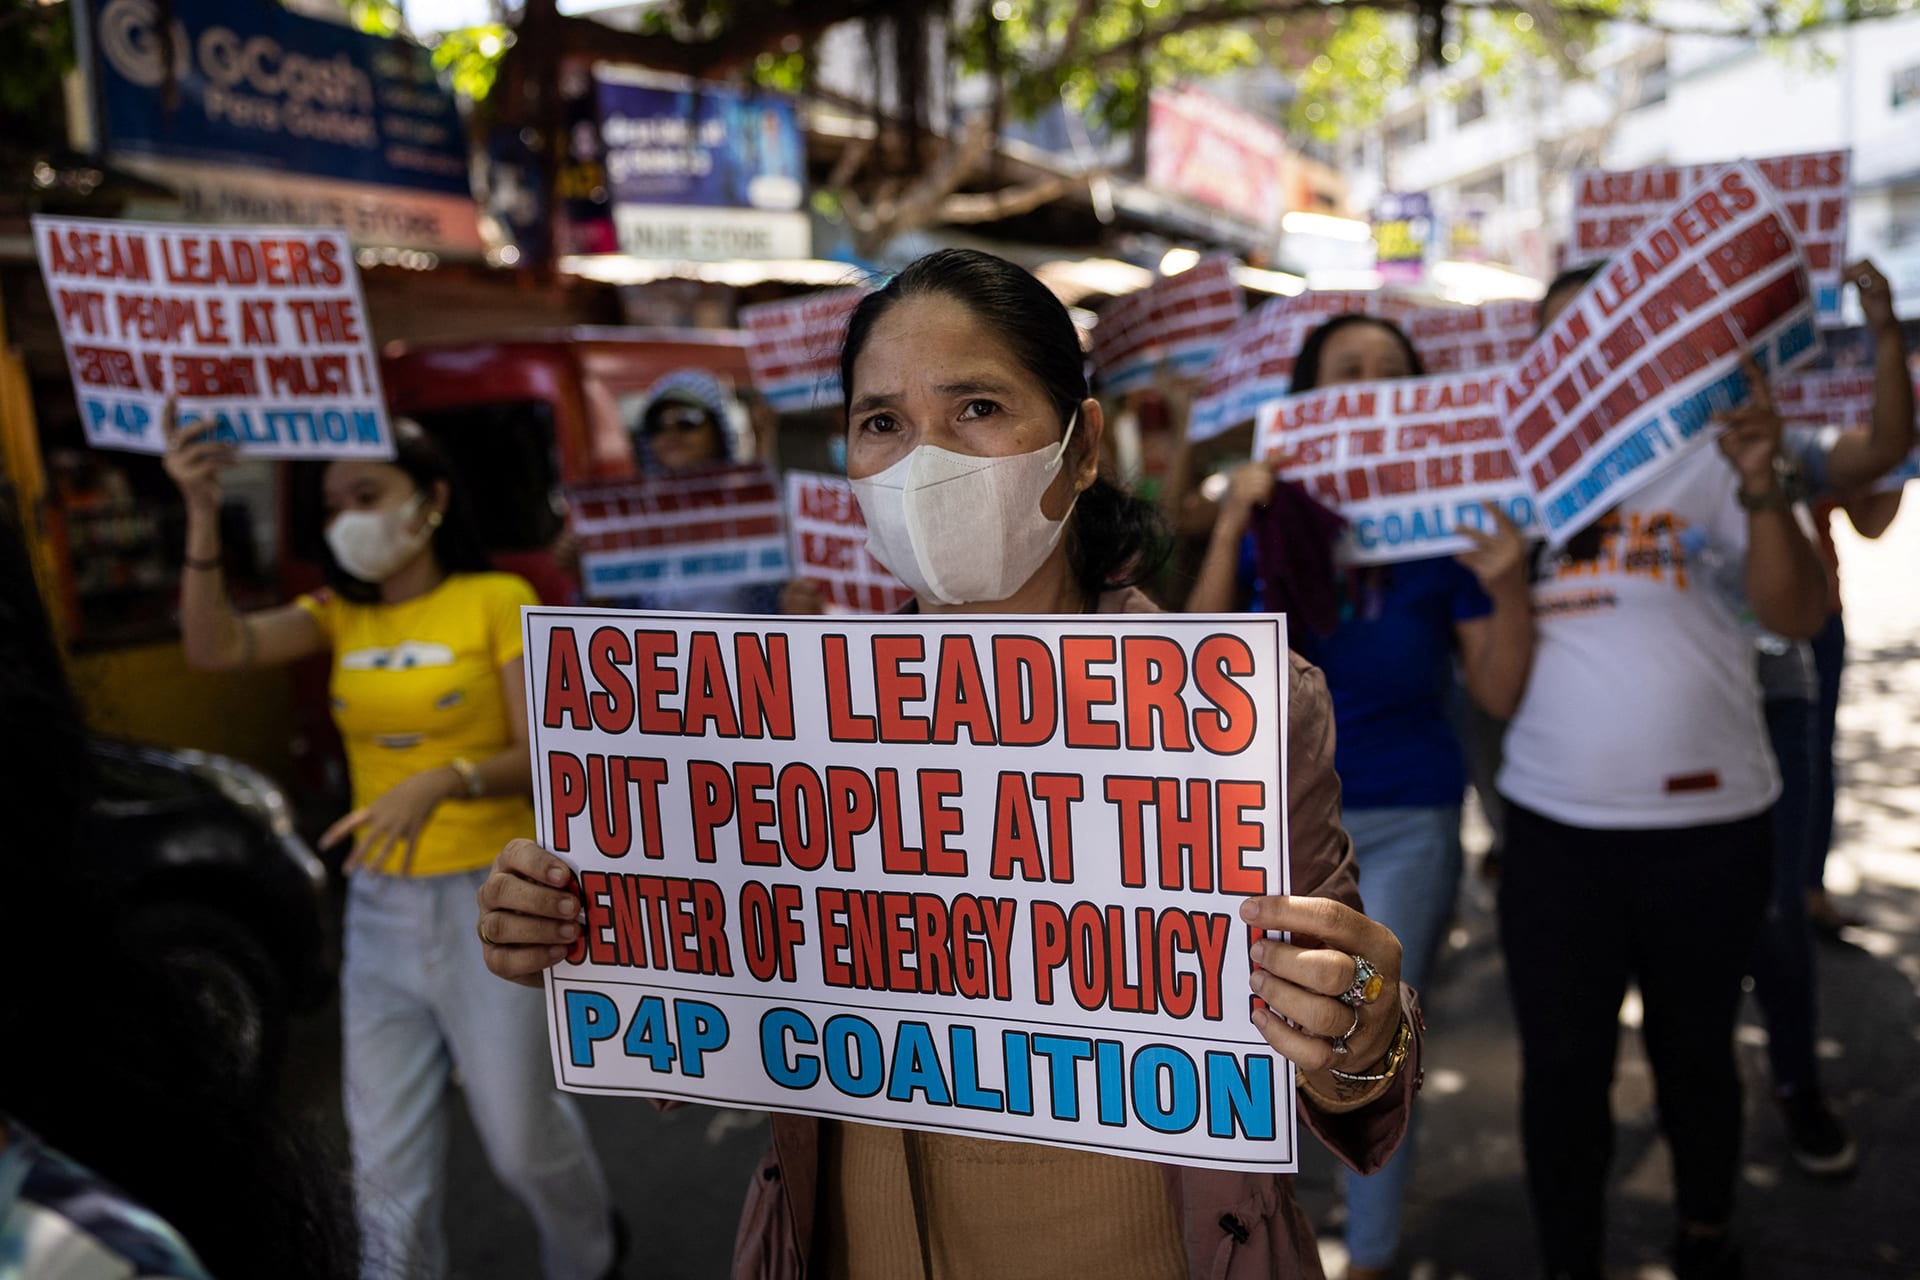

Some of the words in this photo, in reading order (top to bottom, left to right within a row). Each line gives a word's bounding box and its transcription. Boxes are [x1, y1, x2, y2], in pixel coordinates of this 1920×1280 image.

[48, 228, 150, 282] ASEAN
[160, 237, 344, 288] LEADERS
[57, 288, 107, 337] PUT
[115, 293, 229, 345] PEOPLE
[240, 299, 278, 346] AT
[287, 299, 360, 345] THE
[1504, 308, 1592, 416] ASEAN
[1592, 171, 1757, 318] LEADERS
[85, 399, 151, 436] P4P
[1269, 391, 1377, 432] ASEAN
[543, 625, 796, 740] ASEAN
[821, 631, 1257, 755] LEADERS
[547, 750, 670, 860] PUT
[686, 758, 968, 878] PEOPLE
[991, 770, 1084, 885] AT
[1104, 773, 1267, 897] THE
[739, 880, 804, 987] OF
[815, 885, 1018, 1006] ENERGY
[1028, 898, 1232, 1021] POLICY
[563, 988, 730, 1079] P4P
[759, 1005, 1277, 1141] COALITION
